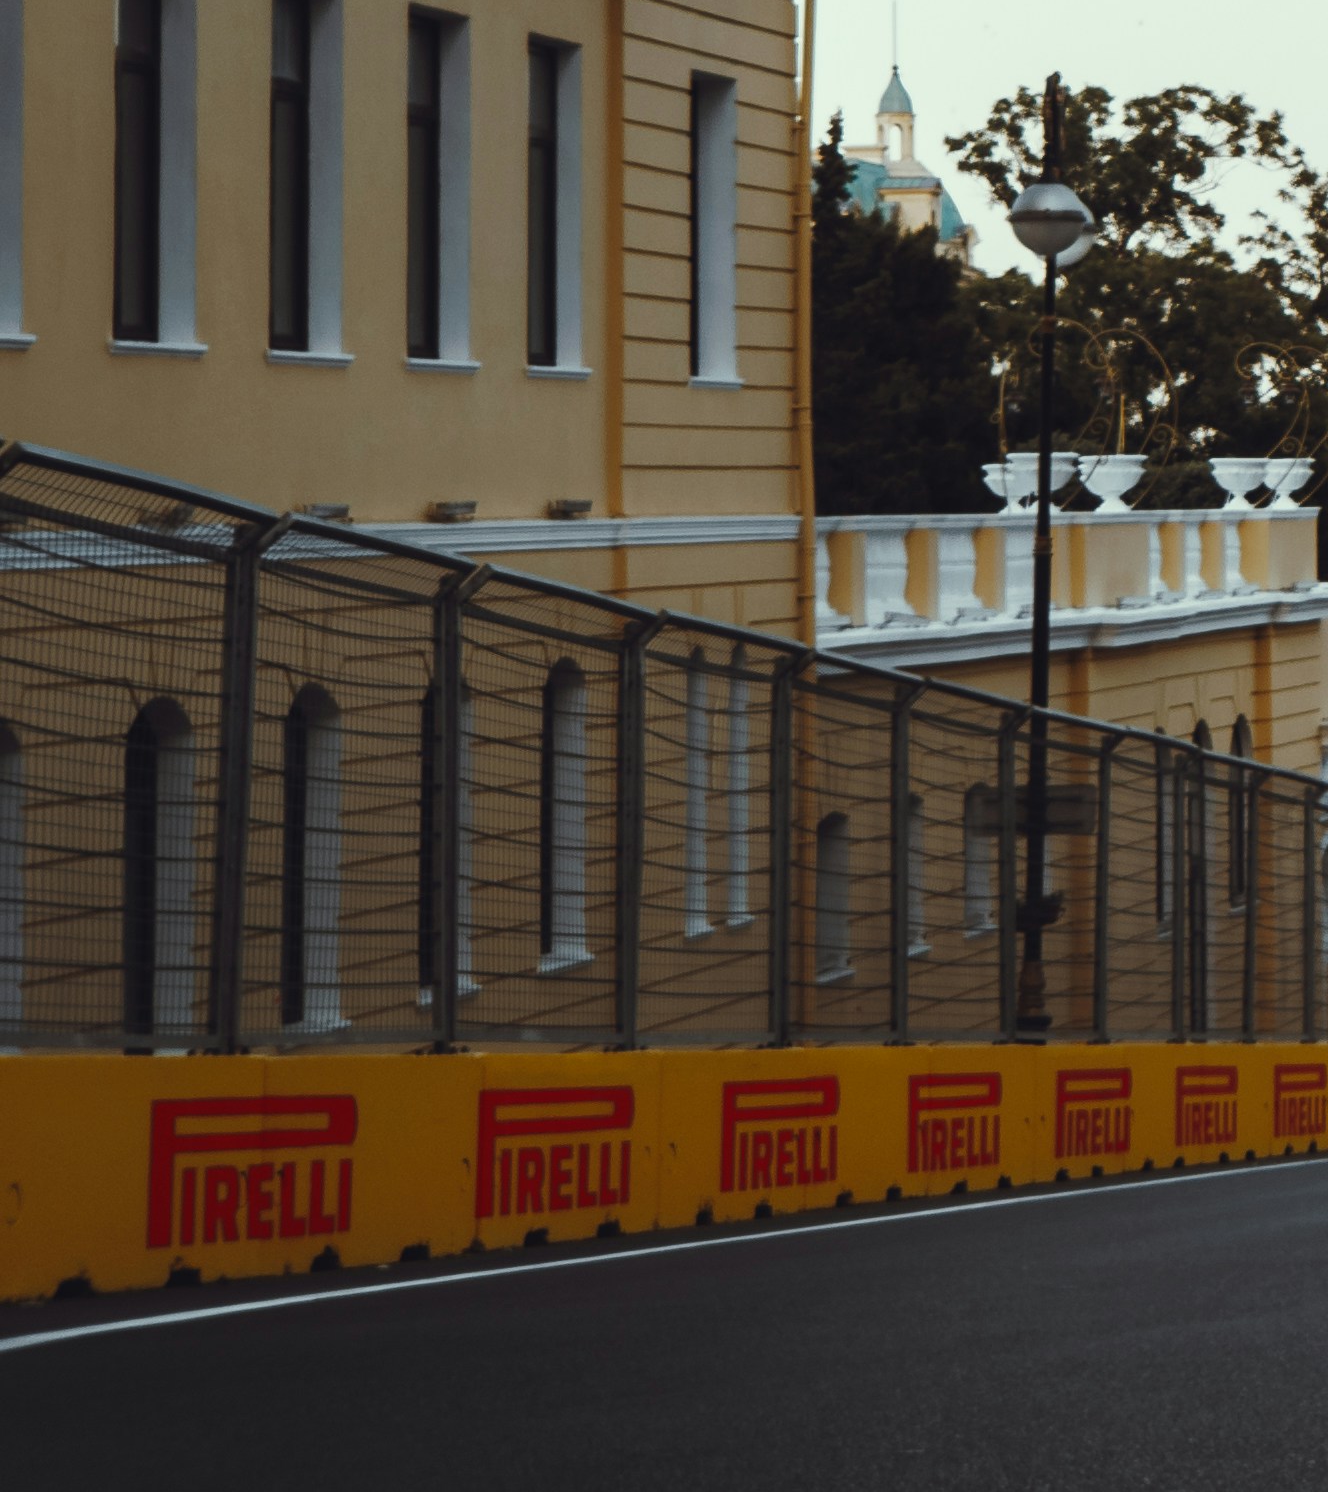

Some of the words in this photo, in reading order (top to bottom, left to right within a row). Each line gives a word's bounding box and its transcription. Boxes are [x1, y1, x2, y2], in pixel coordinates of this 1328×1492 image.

[719, 1075, 840, 1194] PIRELLI
[907, 1071, 1002, 1173] PIRELLI
[1054, 1067, 1132, 1158] PIRELLI
[1175, 1065, 1238, 1148] PIRELLI
[1273, 1064, 1327, 1138] PIRELLI
[145, 1094, 359, 1250] PIRELLI
[474, 1085, 635, 1222] PIRELLI
